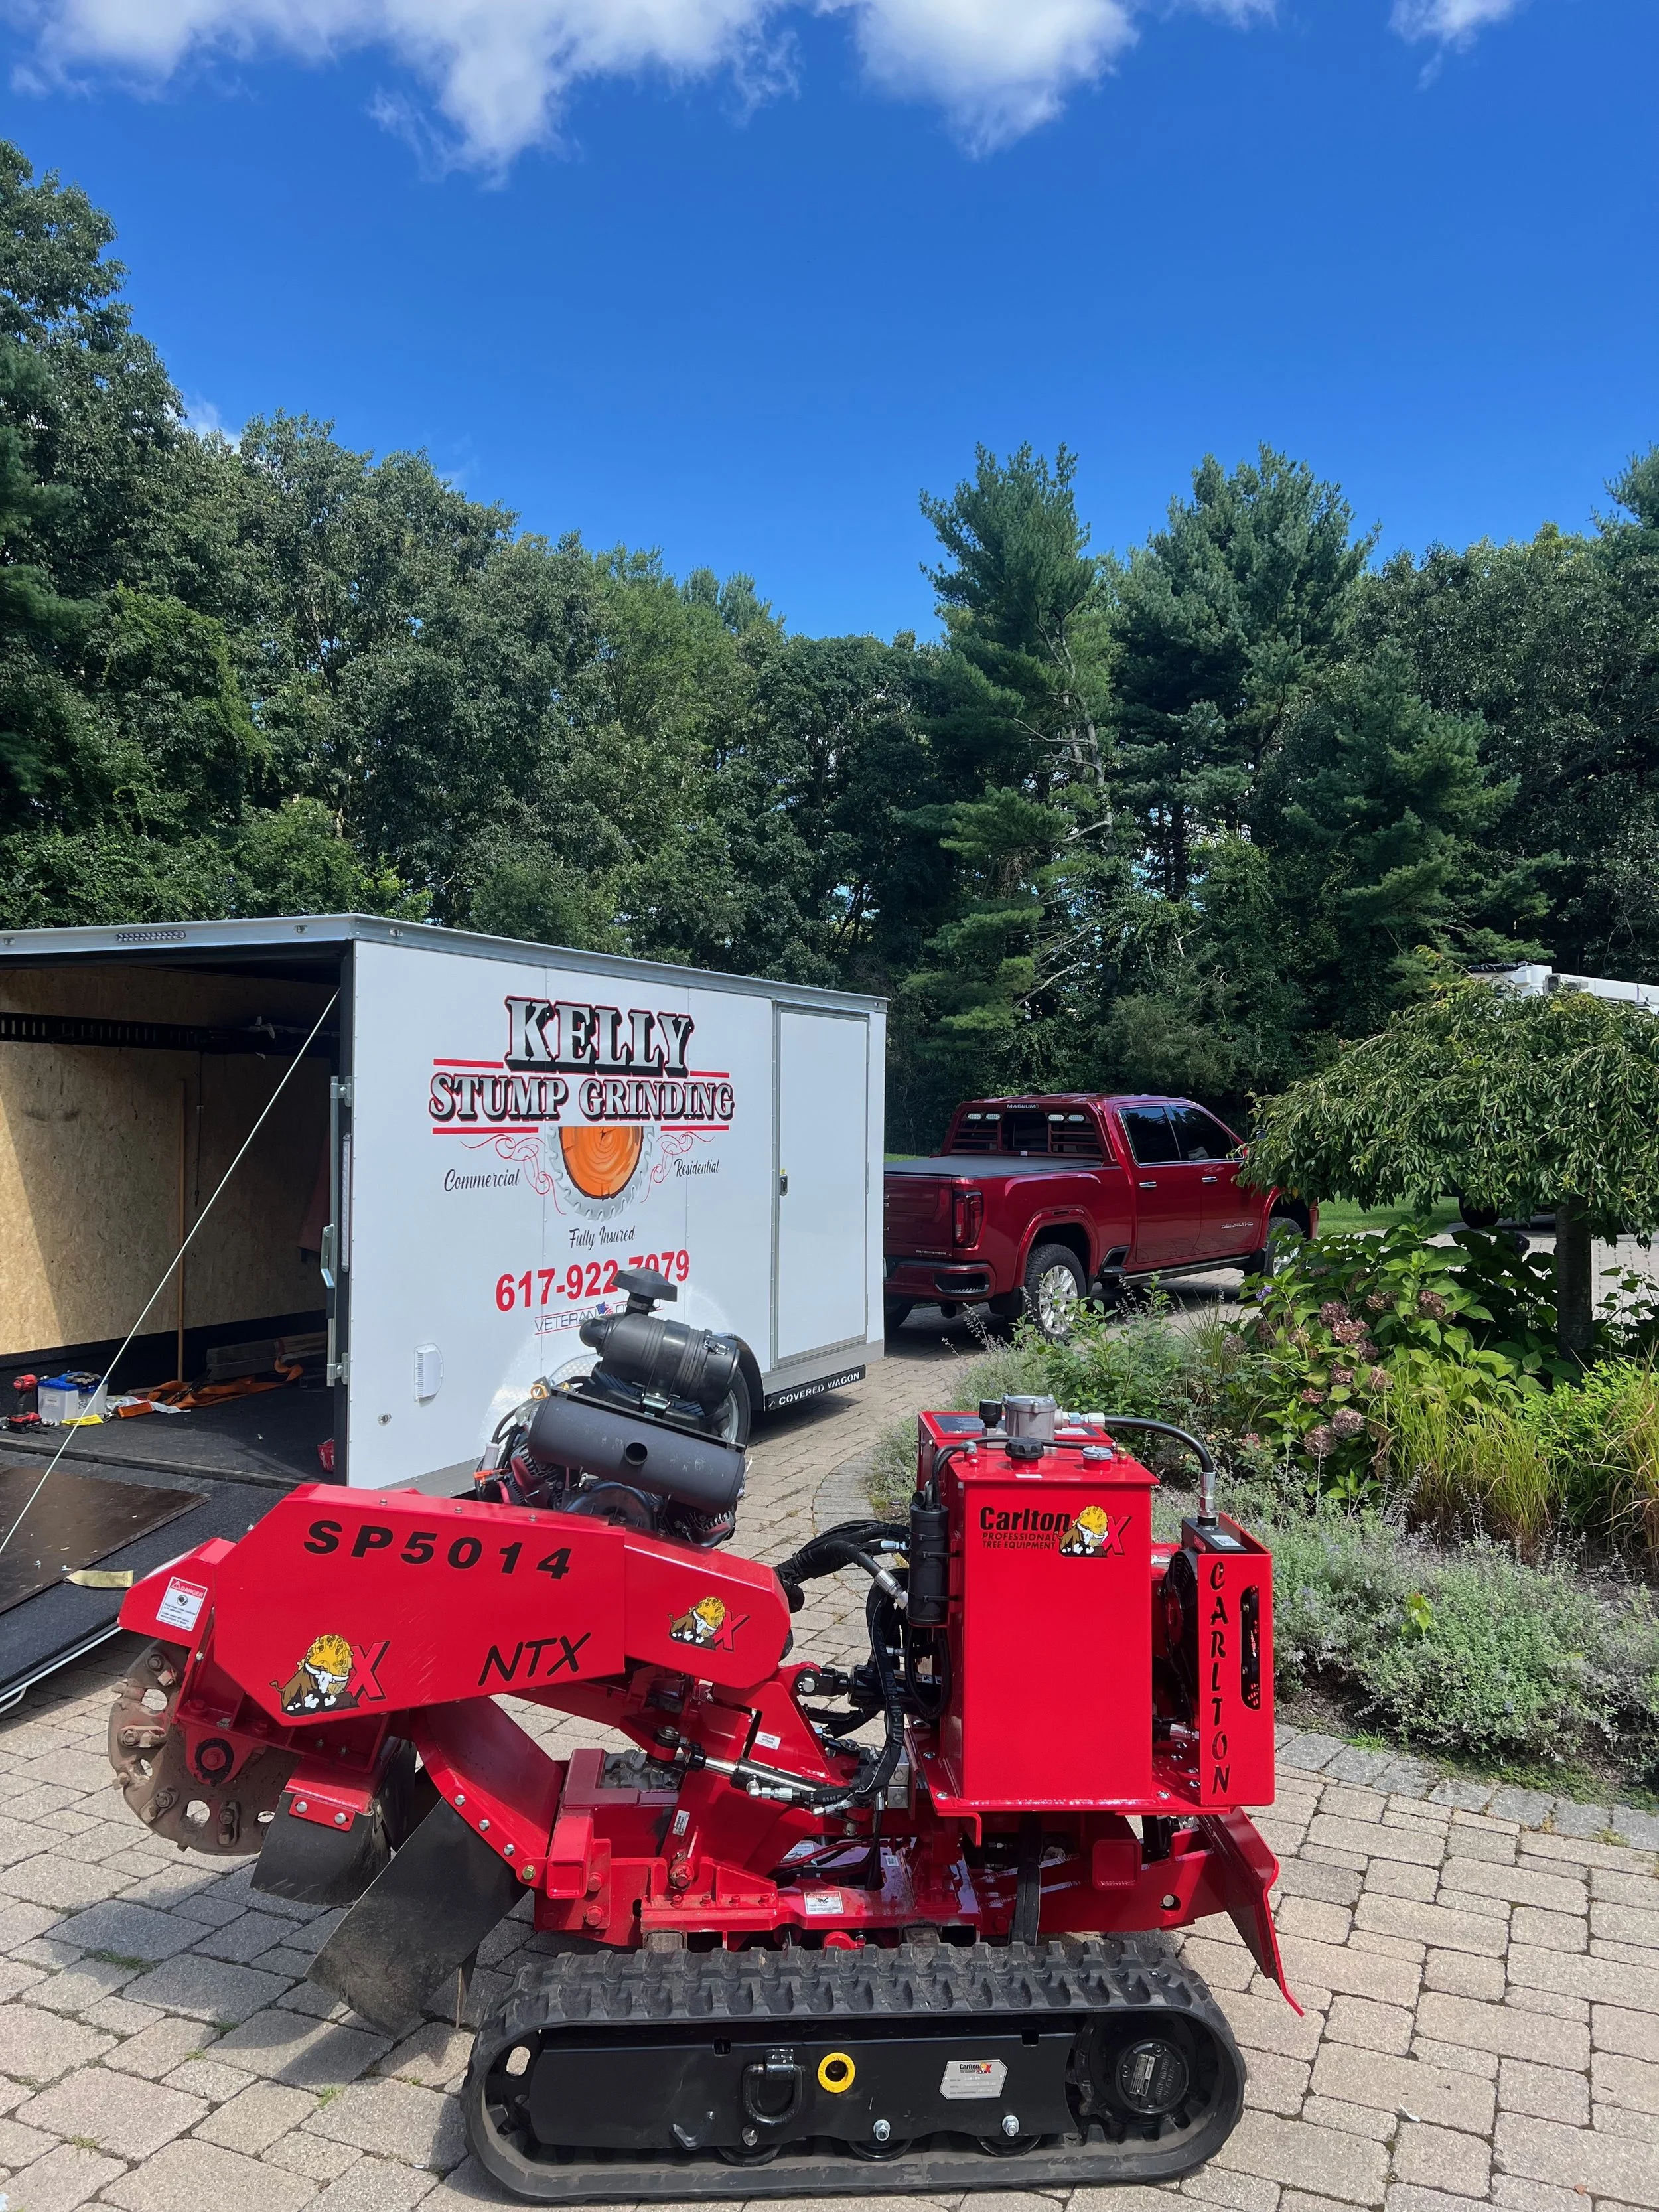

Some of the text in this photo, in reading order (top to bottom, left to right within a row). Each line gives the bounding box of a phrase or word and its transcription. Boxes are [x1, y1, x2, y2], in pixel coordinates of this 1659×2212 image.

[504, 995, 695, 1078] KELLY
[428, 1071, 735, 1122] STUMP GRINDING
[443, 1169, 520, 1192] Commercial
[674, 1159, 719, 1177] Residential
[569, 1226, 636, 1250] Fully Insured
[778, 1372, 860, 1405] COVERED WAGON
[980, 1507, 1070, 1533] Carlton
[303, 1520, 571, 1580] SP5014
[982, 1532, 1056, 1542] PROFESSIONAL
[983, 1540, 1055, 1550] TREE EQUIPMENT
[180, 1585, 204, 1599] DANGER
[477, 1631, 591, 1687] NTX
[1209, 1560, 1231, 1795] CARLTON
